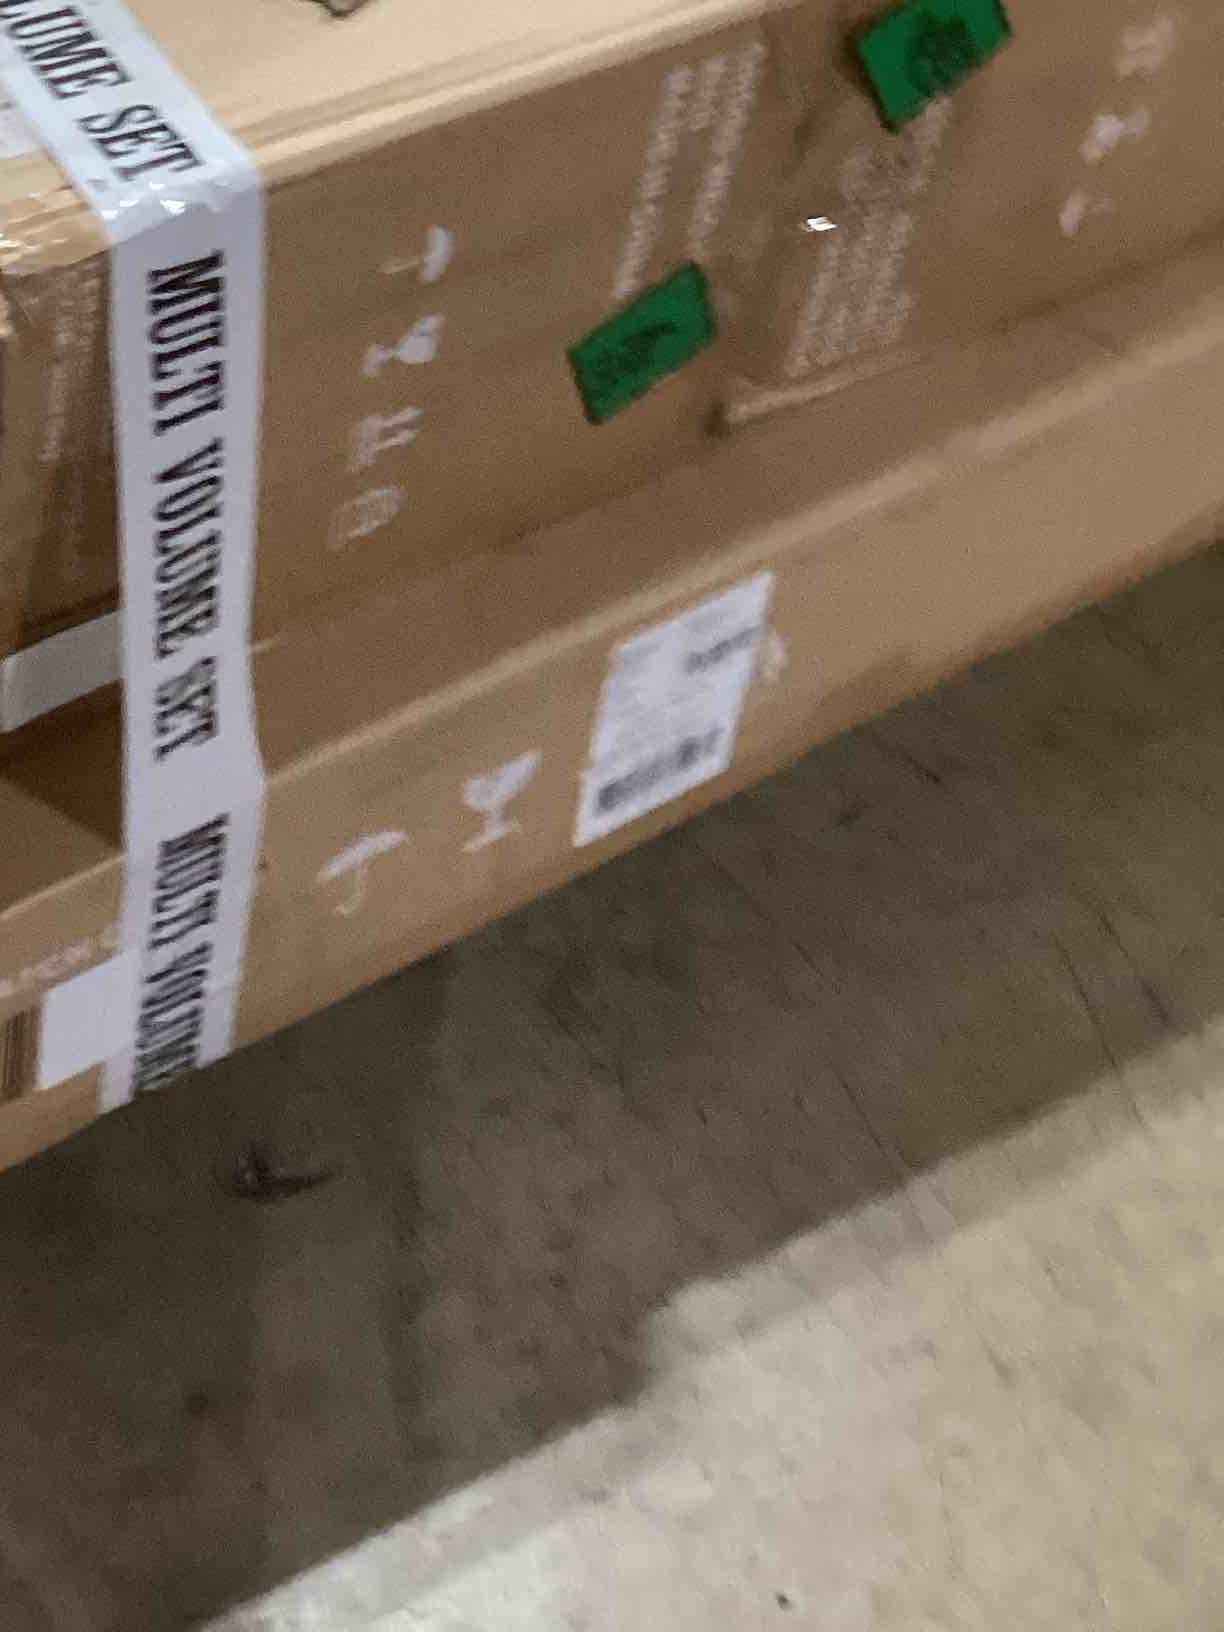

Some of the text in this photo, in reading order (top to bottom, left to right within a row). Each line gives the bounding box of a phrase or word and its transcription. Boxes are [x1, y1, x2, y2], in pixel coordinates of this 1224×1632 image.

[75, 102, 208, 186] SET
[146, 250, 225, 762] MULTI VOLUME SET
[146, 812, 230, 950] MULTI
